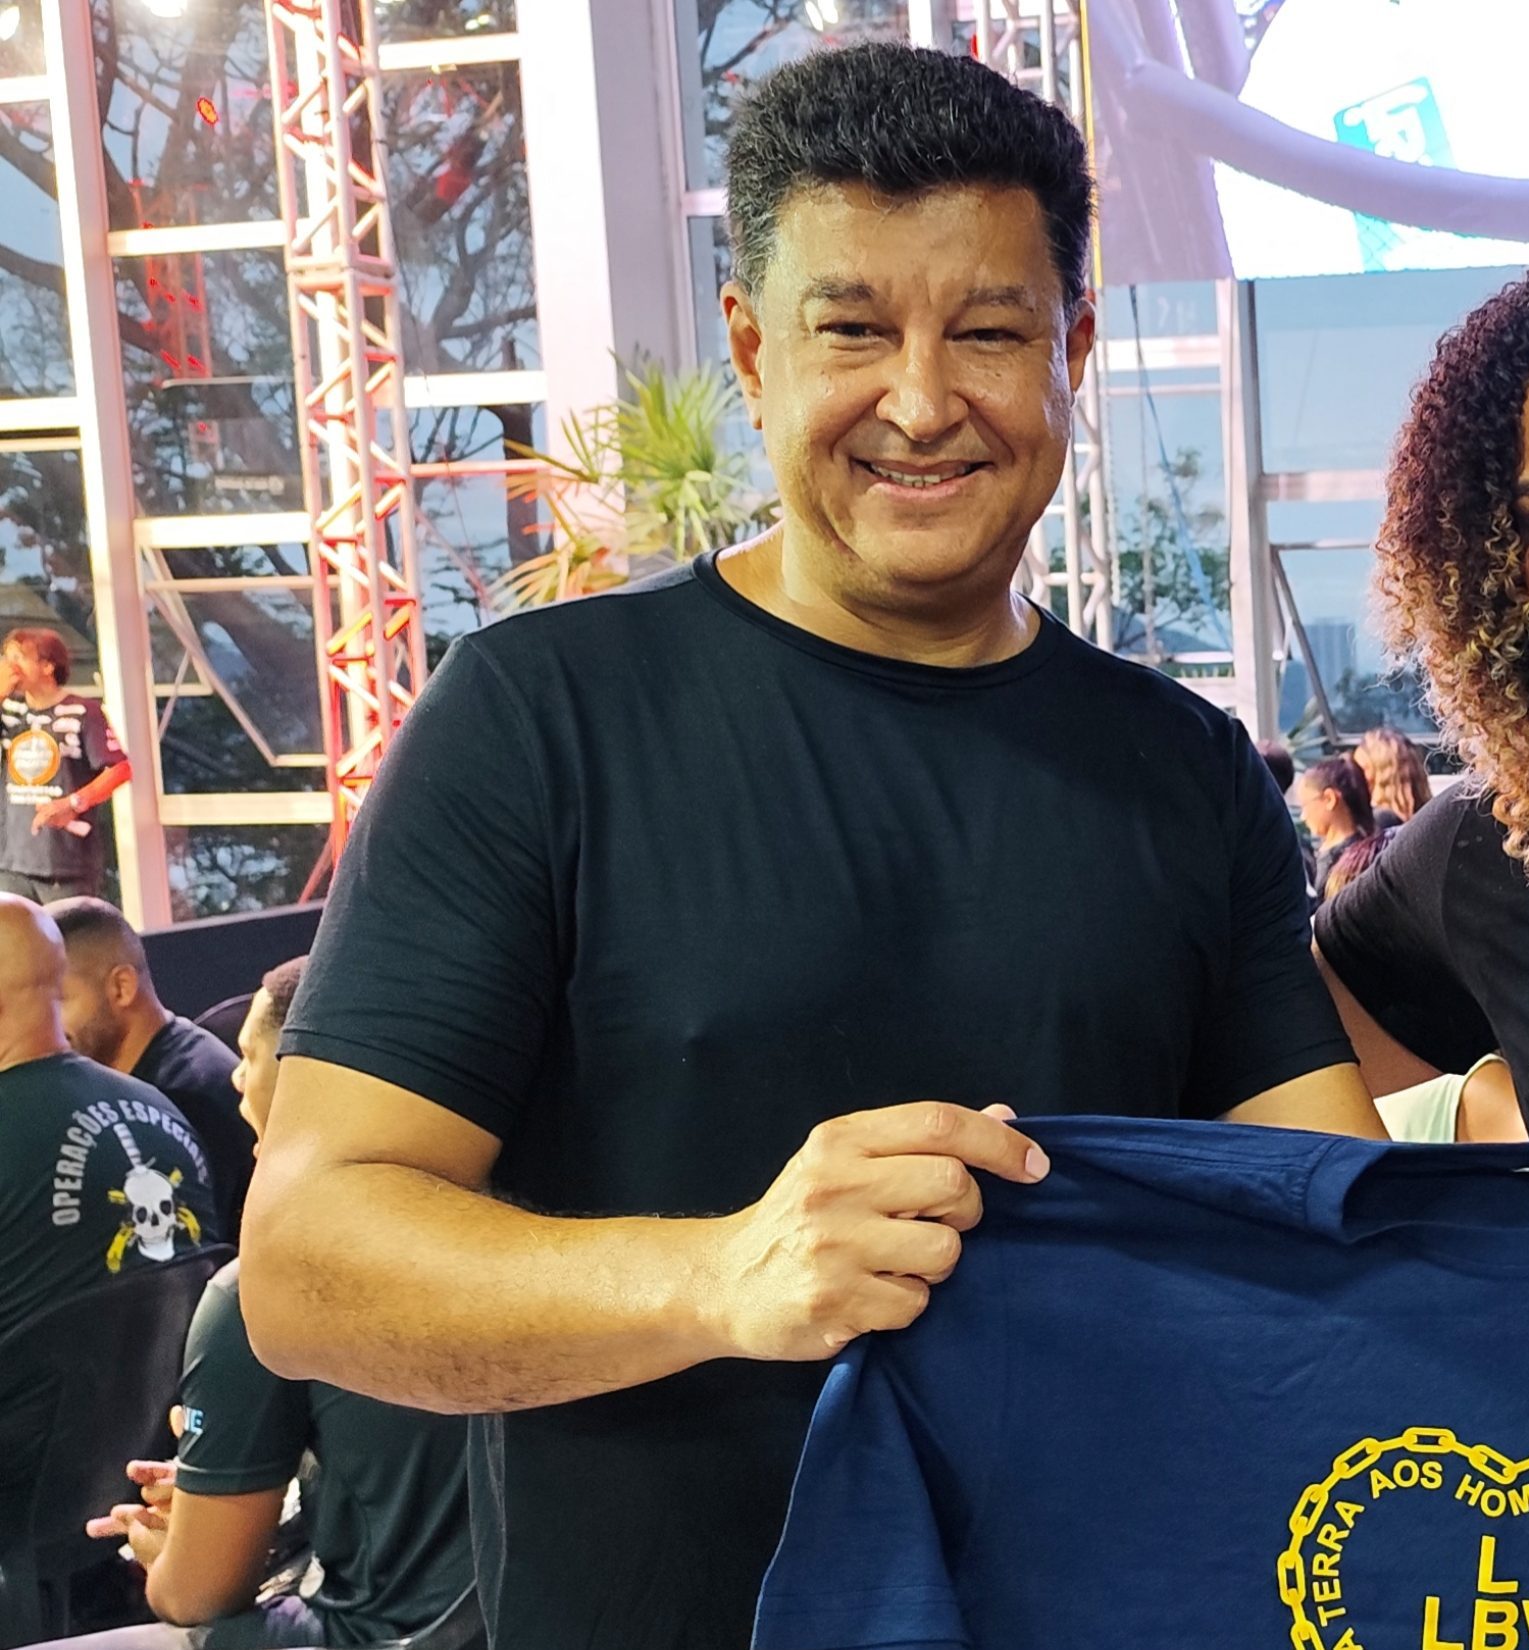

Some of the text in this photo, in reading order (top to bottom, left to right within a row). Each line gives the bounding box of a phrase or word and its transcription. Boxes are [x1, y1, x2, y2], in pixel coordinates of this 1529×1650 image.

[52, 1101, 119, 1226] OPERAÇÕES
[1312, 1501, 1365, 1627] TERRA
[1370, 1459, 1443, 1499] AOS
[1477, 1535, 1518, 1593] L
